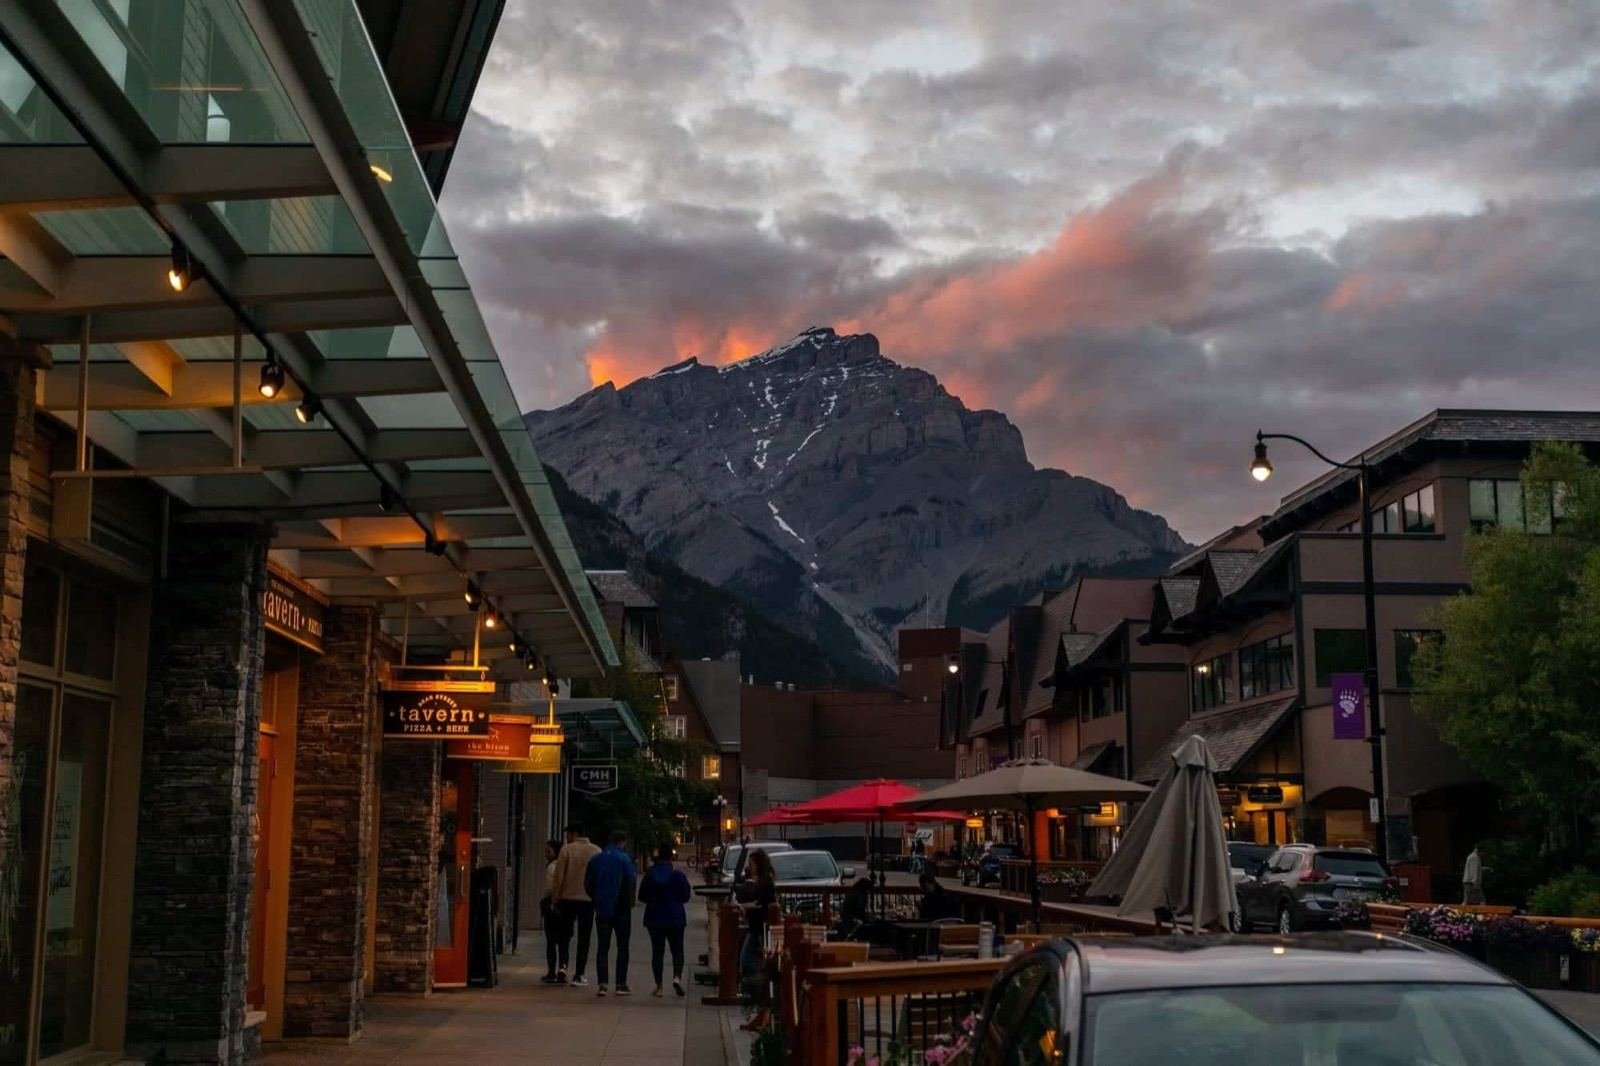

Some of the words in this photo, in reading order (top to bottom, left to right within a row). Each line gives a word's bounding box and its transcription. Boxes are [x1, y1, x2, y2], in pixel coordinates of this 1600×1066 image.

[399, 706, 474, 722] tavern
[404, 724, 432, 733] PIZZA
[446, 724, 469, 733] BEER
[580, 770, 609, 780] CMH
